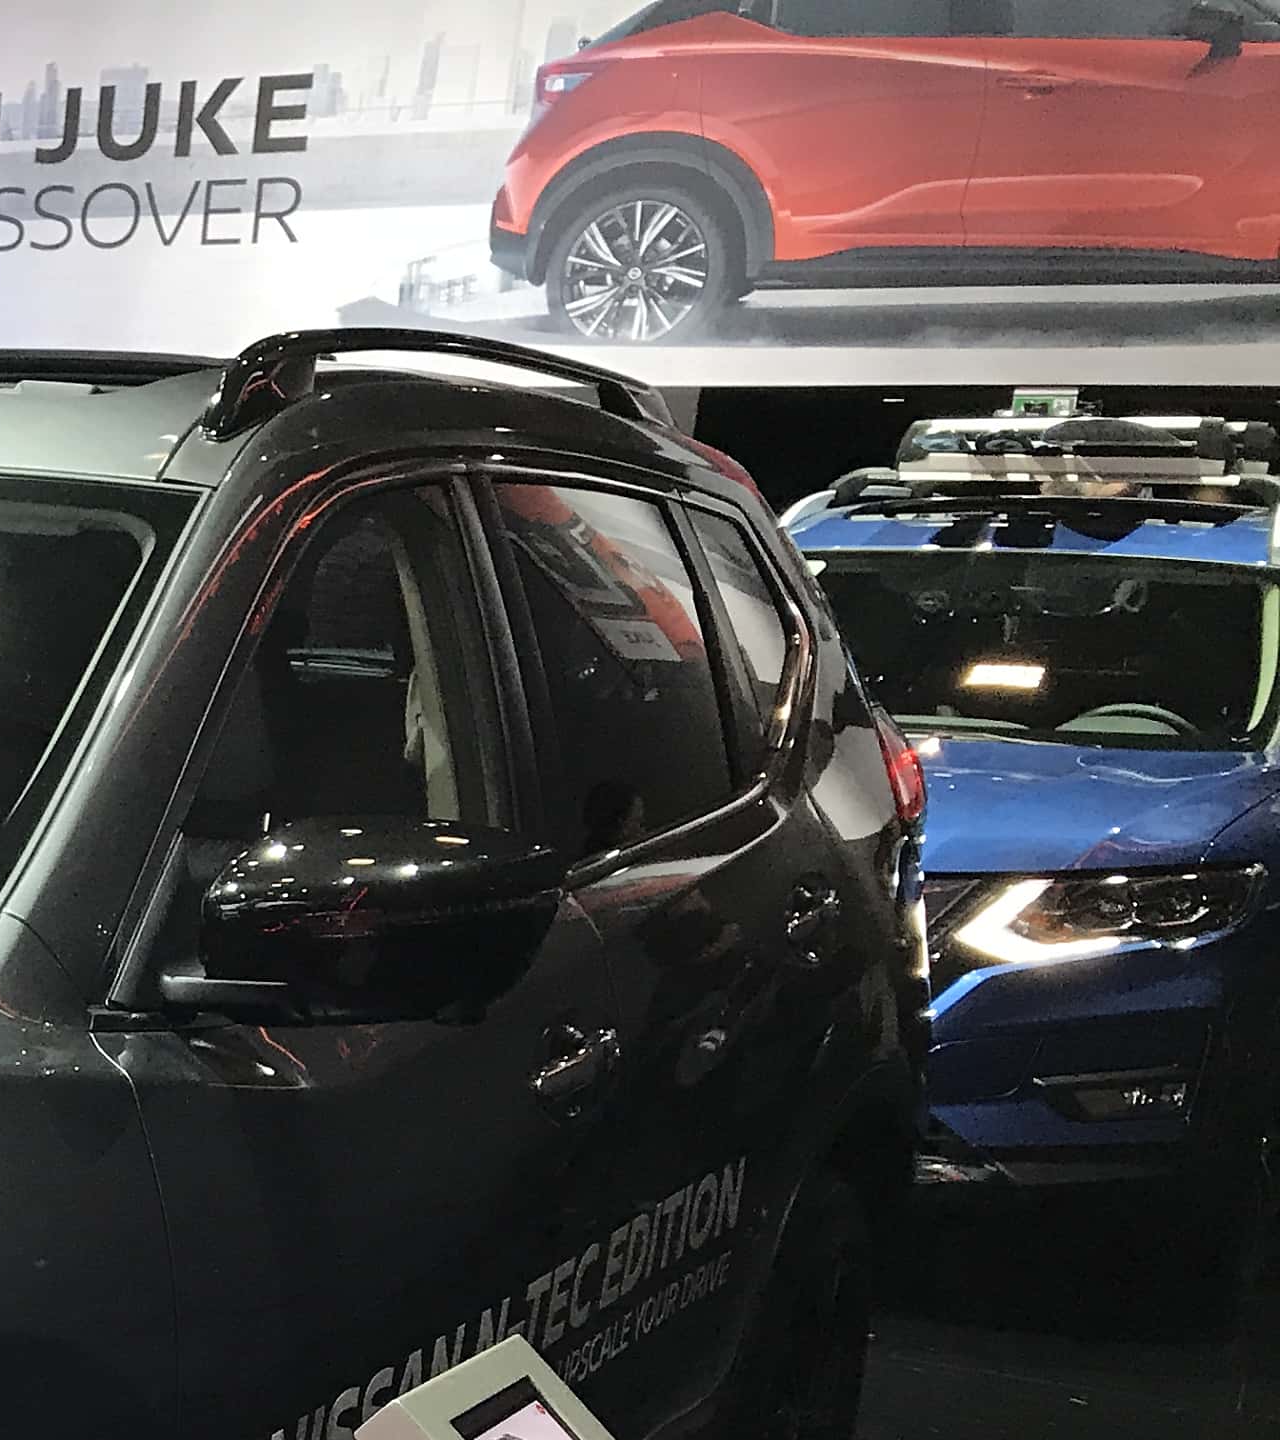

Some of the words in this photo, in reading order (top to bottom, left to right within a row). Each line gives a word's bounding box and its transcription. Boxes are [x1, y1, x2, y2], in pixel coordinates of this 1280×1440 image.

[34, 72, 314, 164] JUKE
[600, 1156, 746, 1310] EDITION
[634, 1281, 681, 1341] YOUR
[680, 1250, 733, 1309] DRIVE
